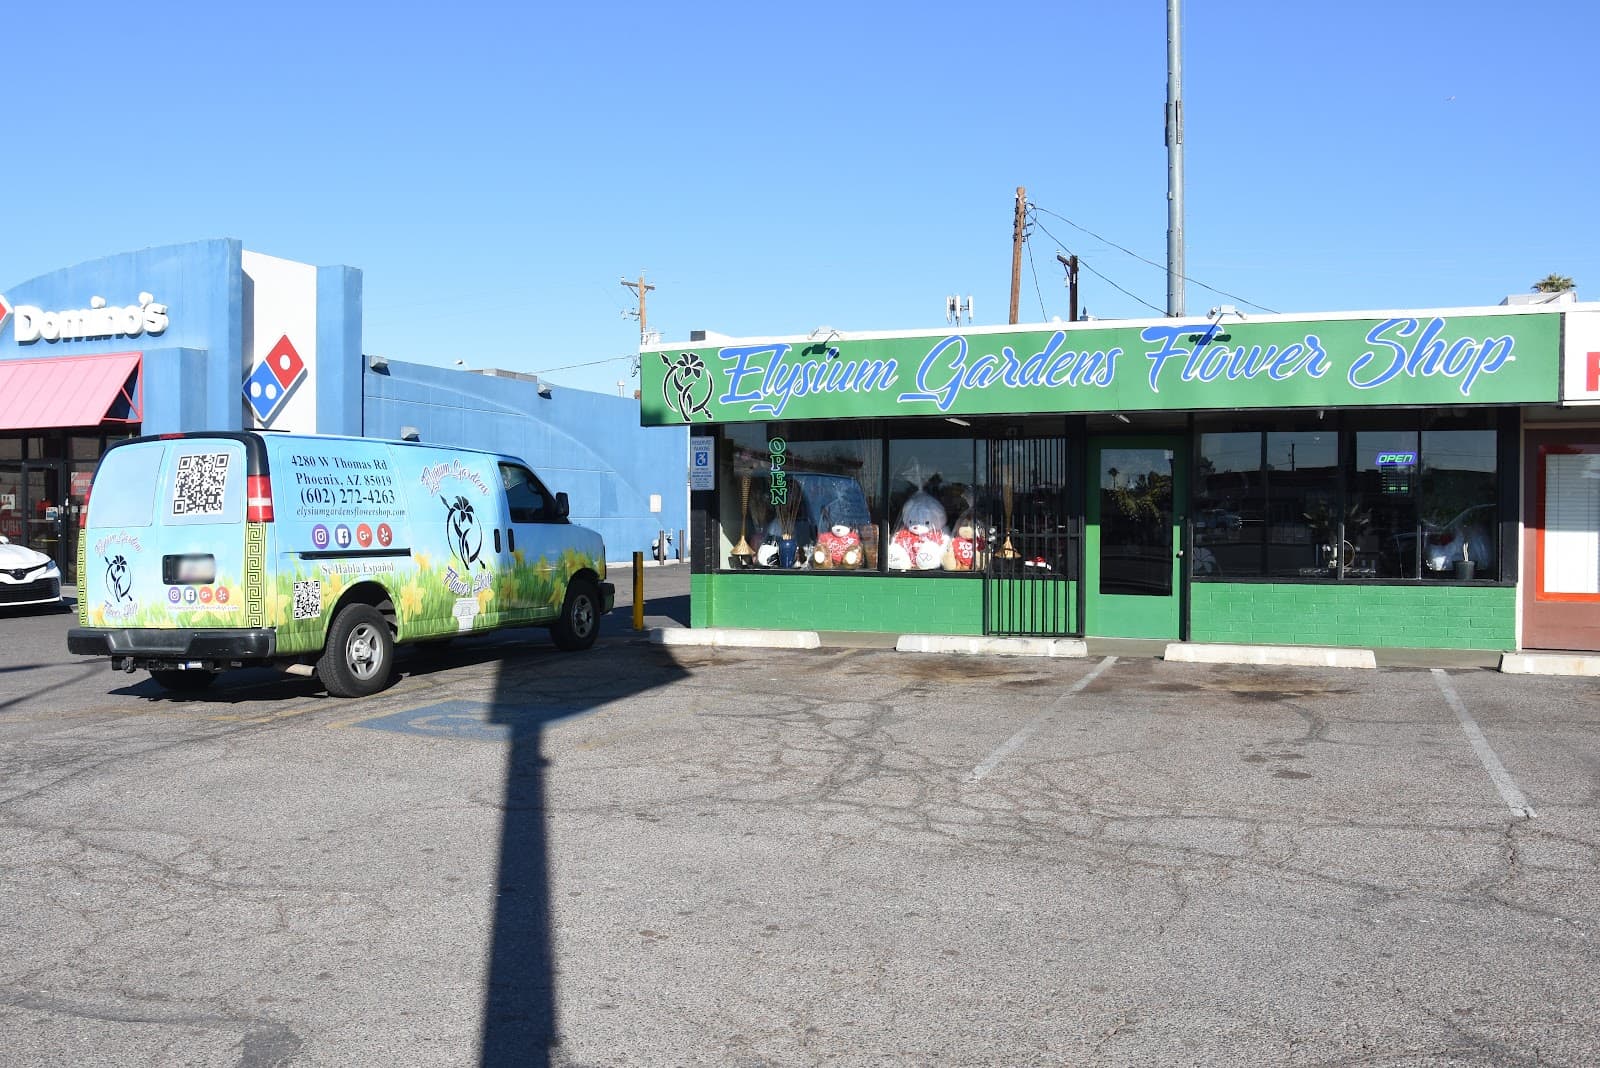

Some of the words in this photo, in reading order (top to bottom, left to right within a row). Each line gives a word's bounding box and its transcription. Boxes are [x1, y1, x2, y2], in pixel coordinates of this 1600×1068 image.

[14, 291, 169, 342] Domino's
[719, 343, 899, 417] Elysium
[898, 330, 1124, 412] Gardens
[1140, 323, 1332, 394] Flower
[1347, 317, 1516, 397] Shop
[291, 455, 316, 467] 4280
[318, 456, 329, 467] W
[332, 457, 372, 470] Thomas
[373, 459, 388, 471] Rd
[1378, 454, 1413, 463] OPEN
[295, 472, 344, 486] Phoenix,
[347, 474, 362, 486] AZ
[363, 475, 392, 487] 85019
[768, 436, 787, 506] OPEN
[300, 487, 336, 506] (602)
[339, 488, 395, 504] 272-4263
